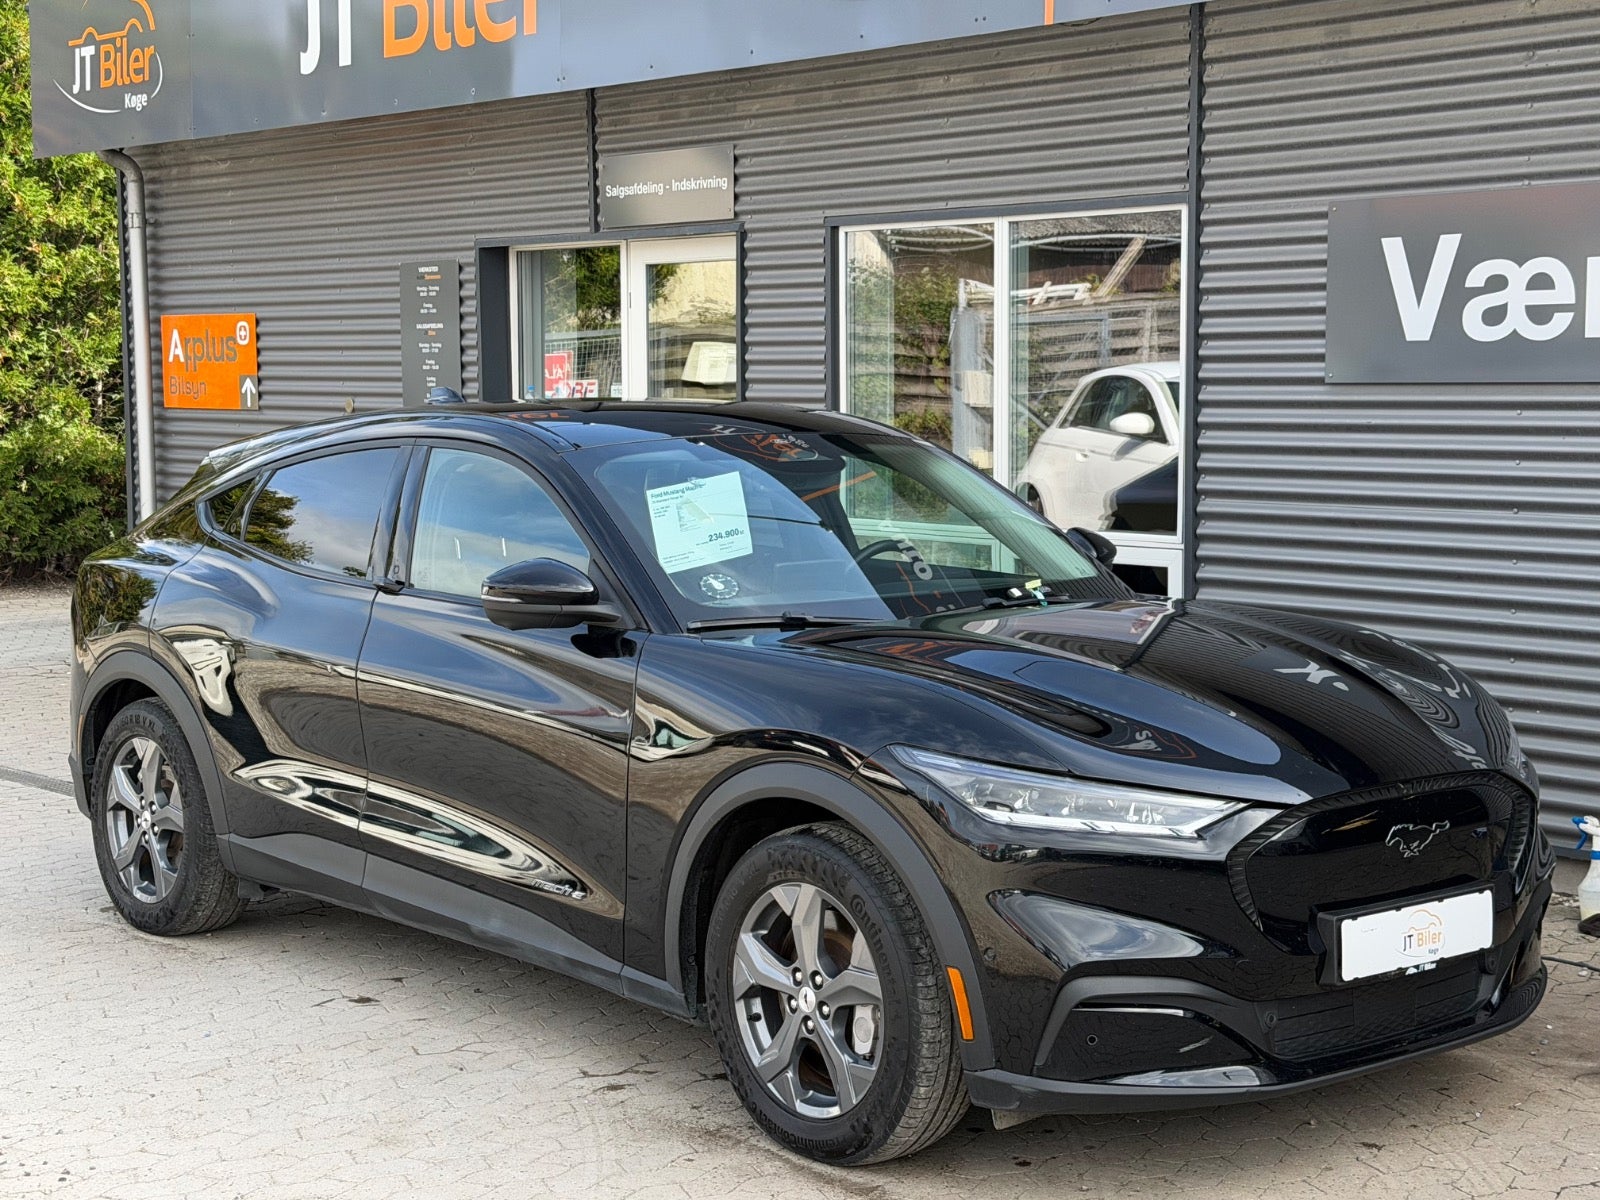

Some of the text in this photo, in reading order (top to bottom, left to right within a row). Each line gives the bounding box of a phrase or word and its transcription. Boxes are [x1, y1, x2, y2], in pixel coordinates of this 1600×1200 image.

[300, 0, 352, 75] JT
[72, 37, 155, 95] JT Biler
[124, 93, 148, 111] Køge
[605, 182, 664, 199] Salgsafdeling
[671, 176, 728, 190] Indskrivning
[169, 376, 207, 400] Bilsyn
[708, 527, 740, 542] 234.900
[1403, 930, 1442, 952] JT Biler
